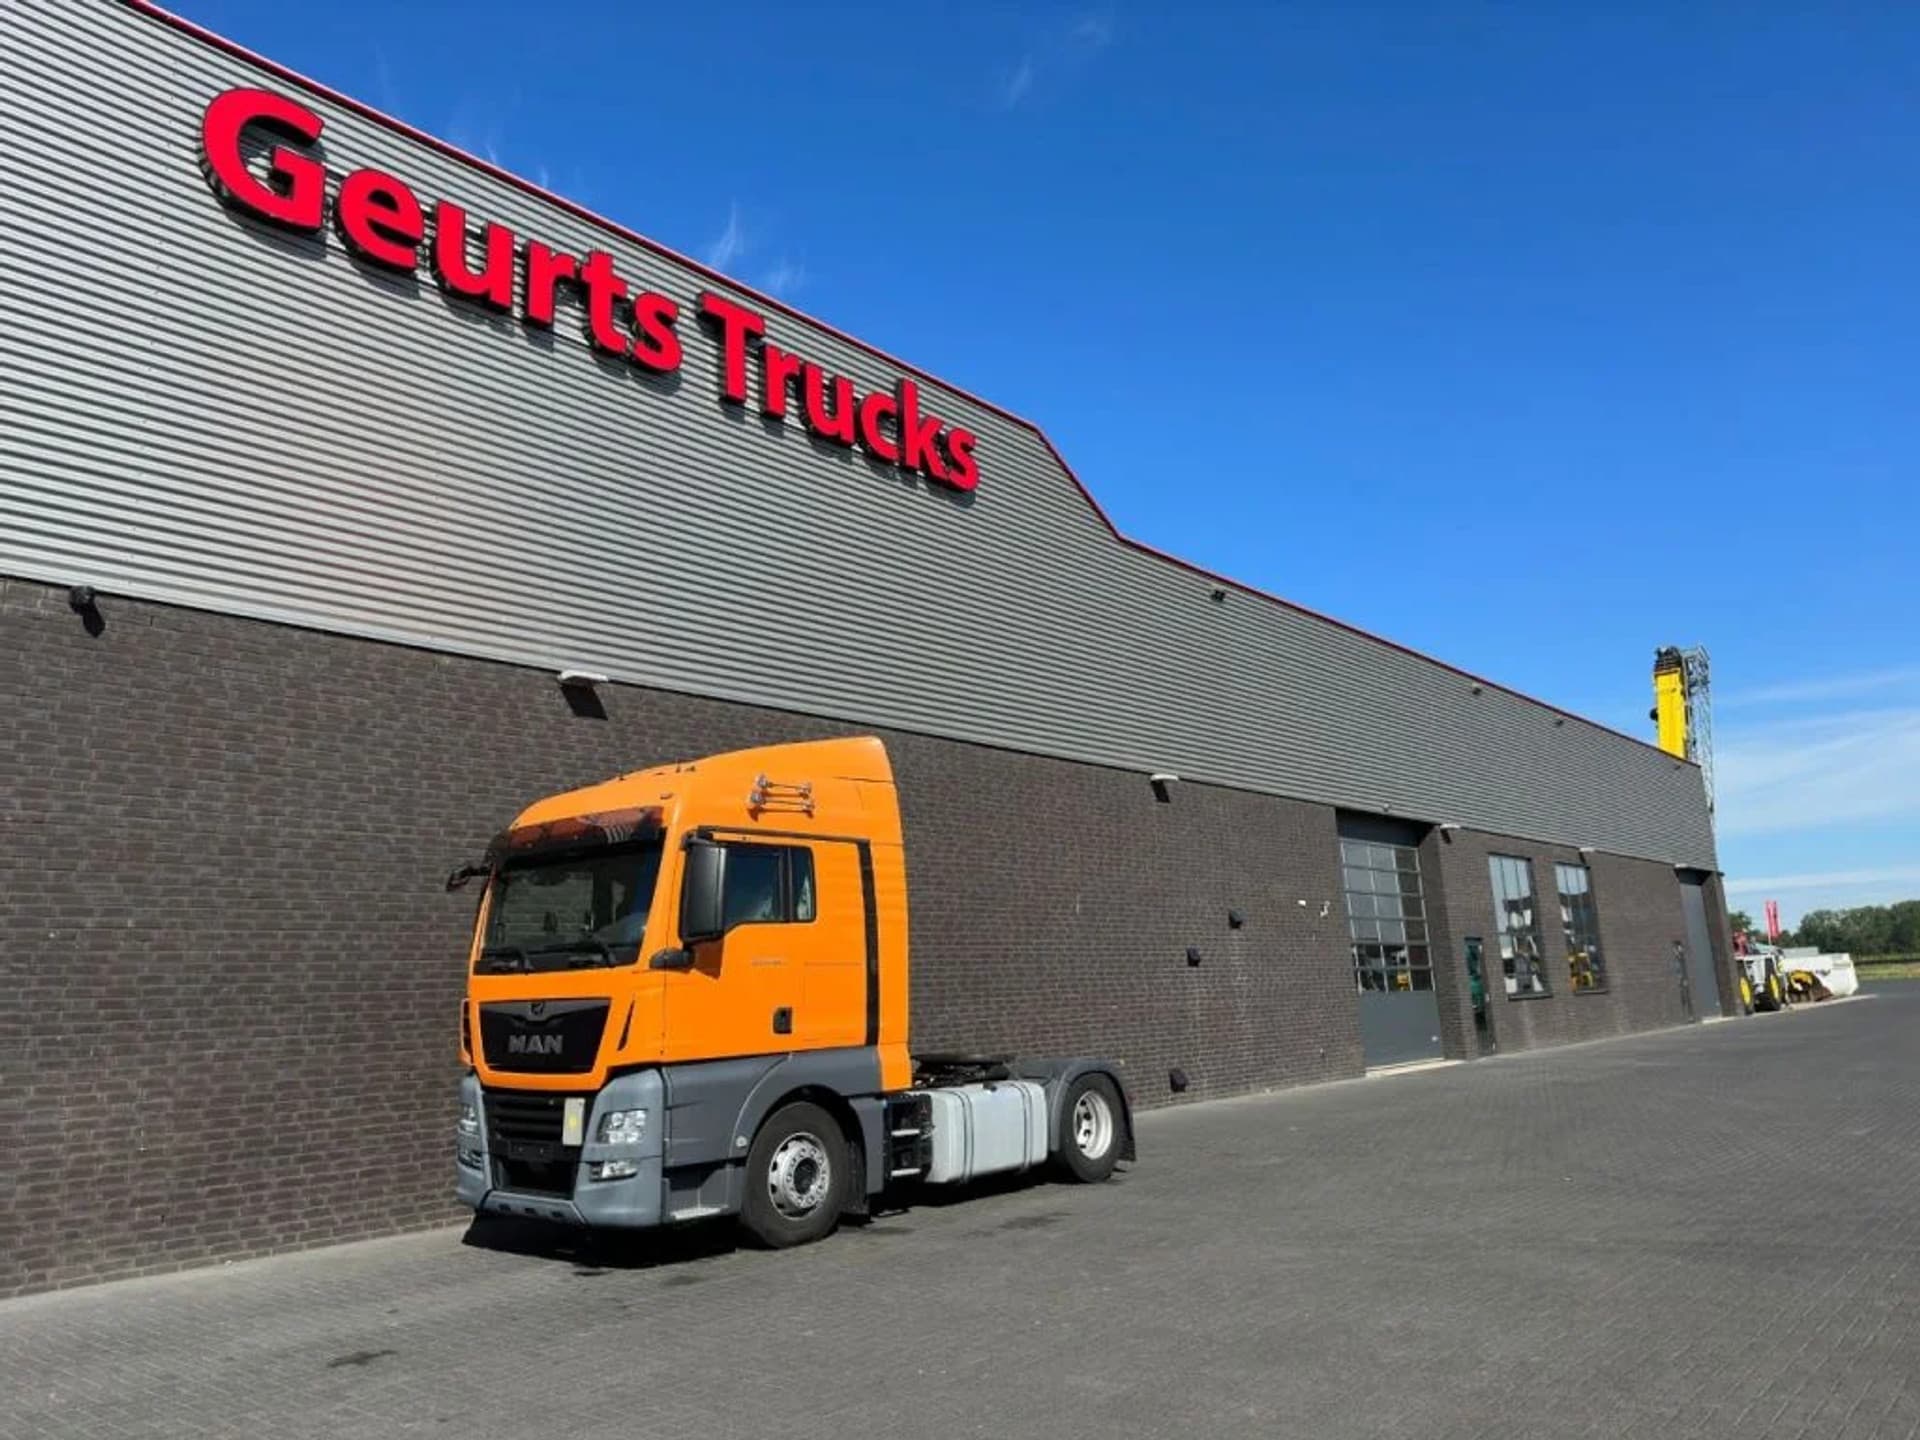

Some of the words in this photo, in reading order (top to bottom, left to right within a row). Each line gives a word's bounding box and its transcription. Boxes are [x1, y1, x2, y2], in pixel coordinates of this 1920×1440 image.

[202, 87, 683, 372] Geurts
[700, 291, 981, 491] Trucks
[508, 1034, 563, 1055] MAN
